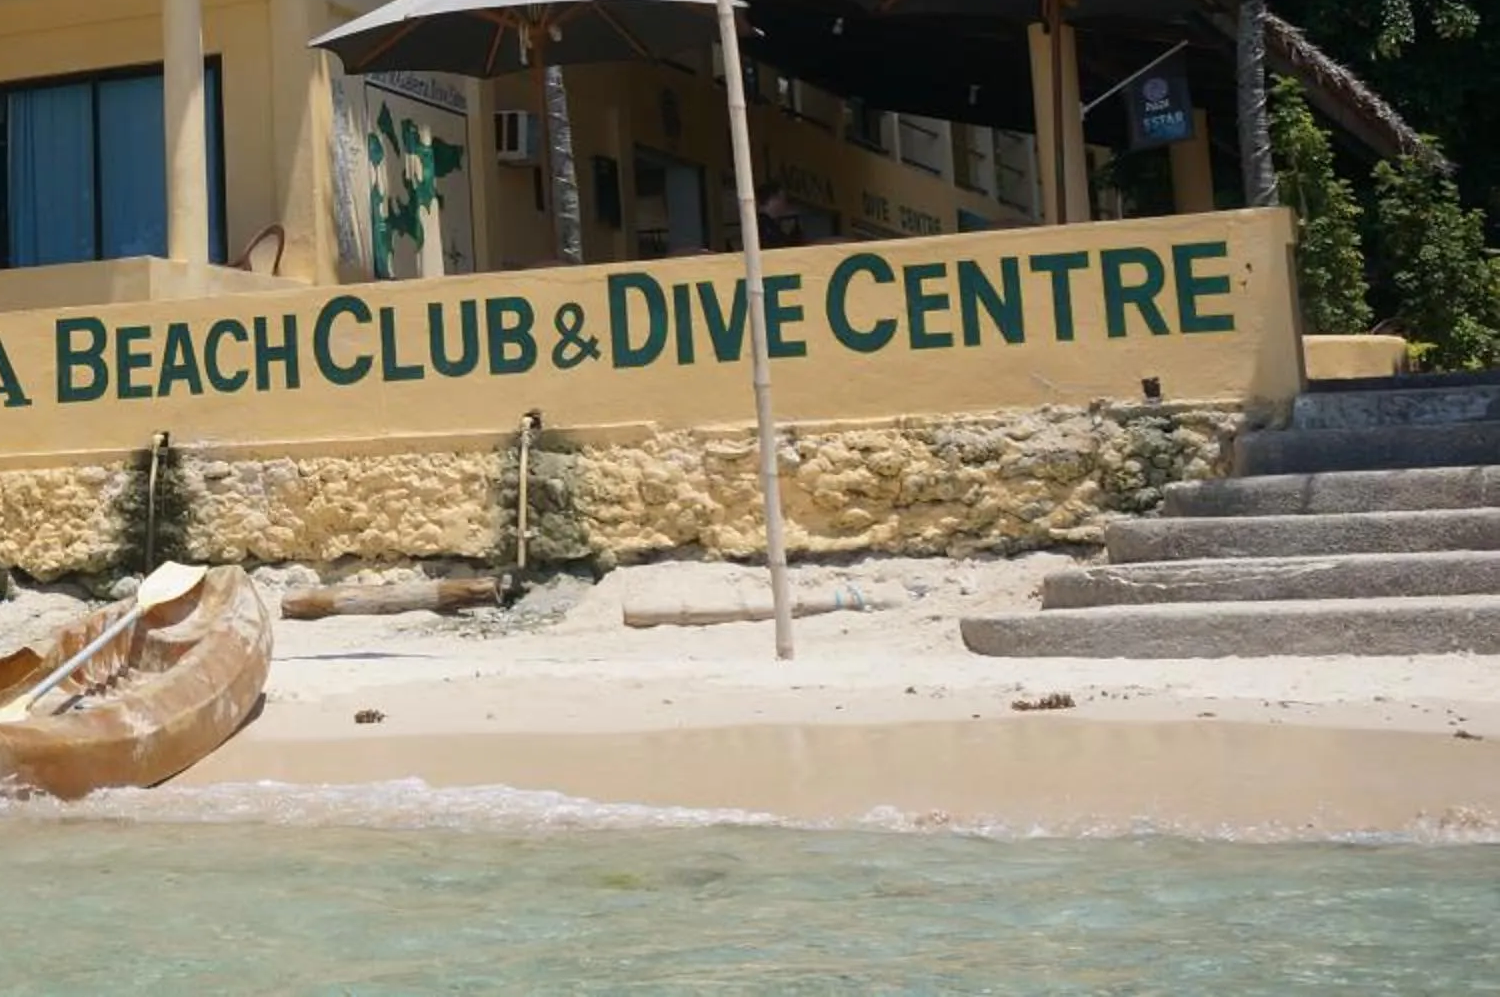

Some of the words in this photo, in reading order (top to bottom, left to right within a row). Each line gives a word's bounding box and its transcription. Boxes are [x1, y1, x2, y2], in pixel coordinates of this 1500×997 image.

[56, 315, 299, 403] BEACH
[313, 295, 538, 388] CLUB
[551, 303, 601, 370] &
[608, 271, 808, 370] DIVE
[826, 240, 1236, 353] CENTRE
